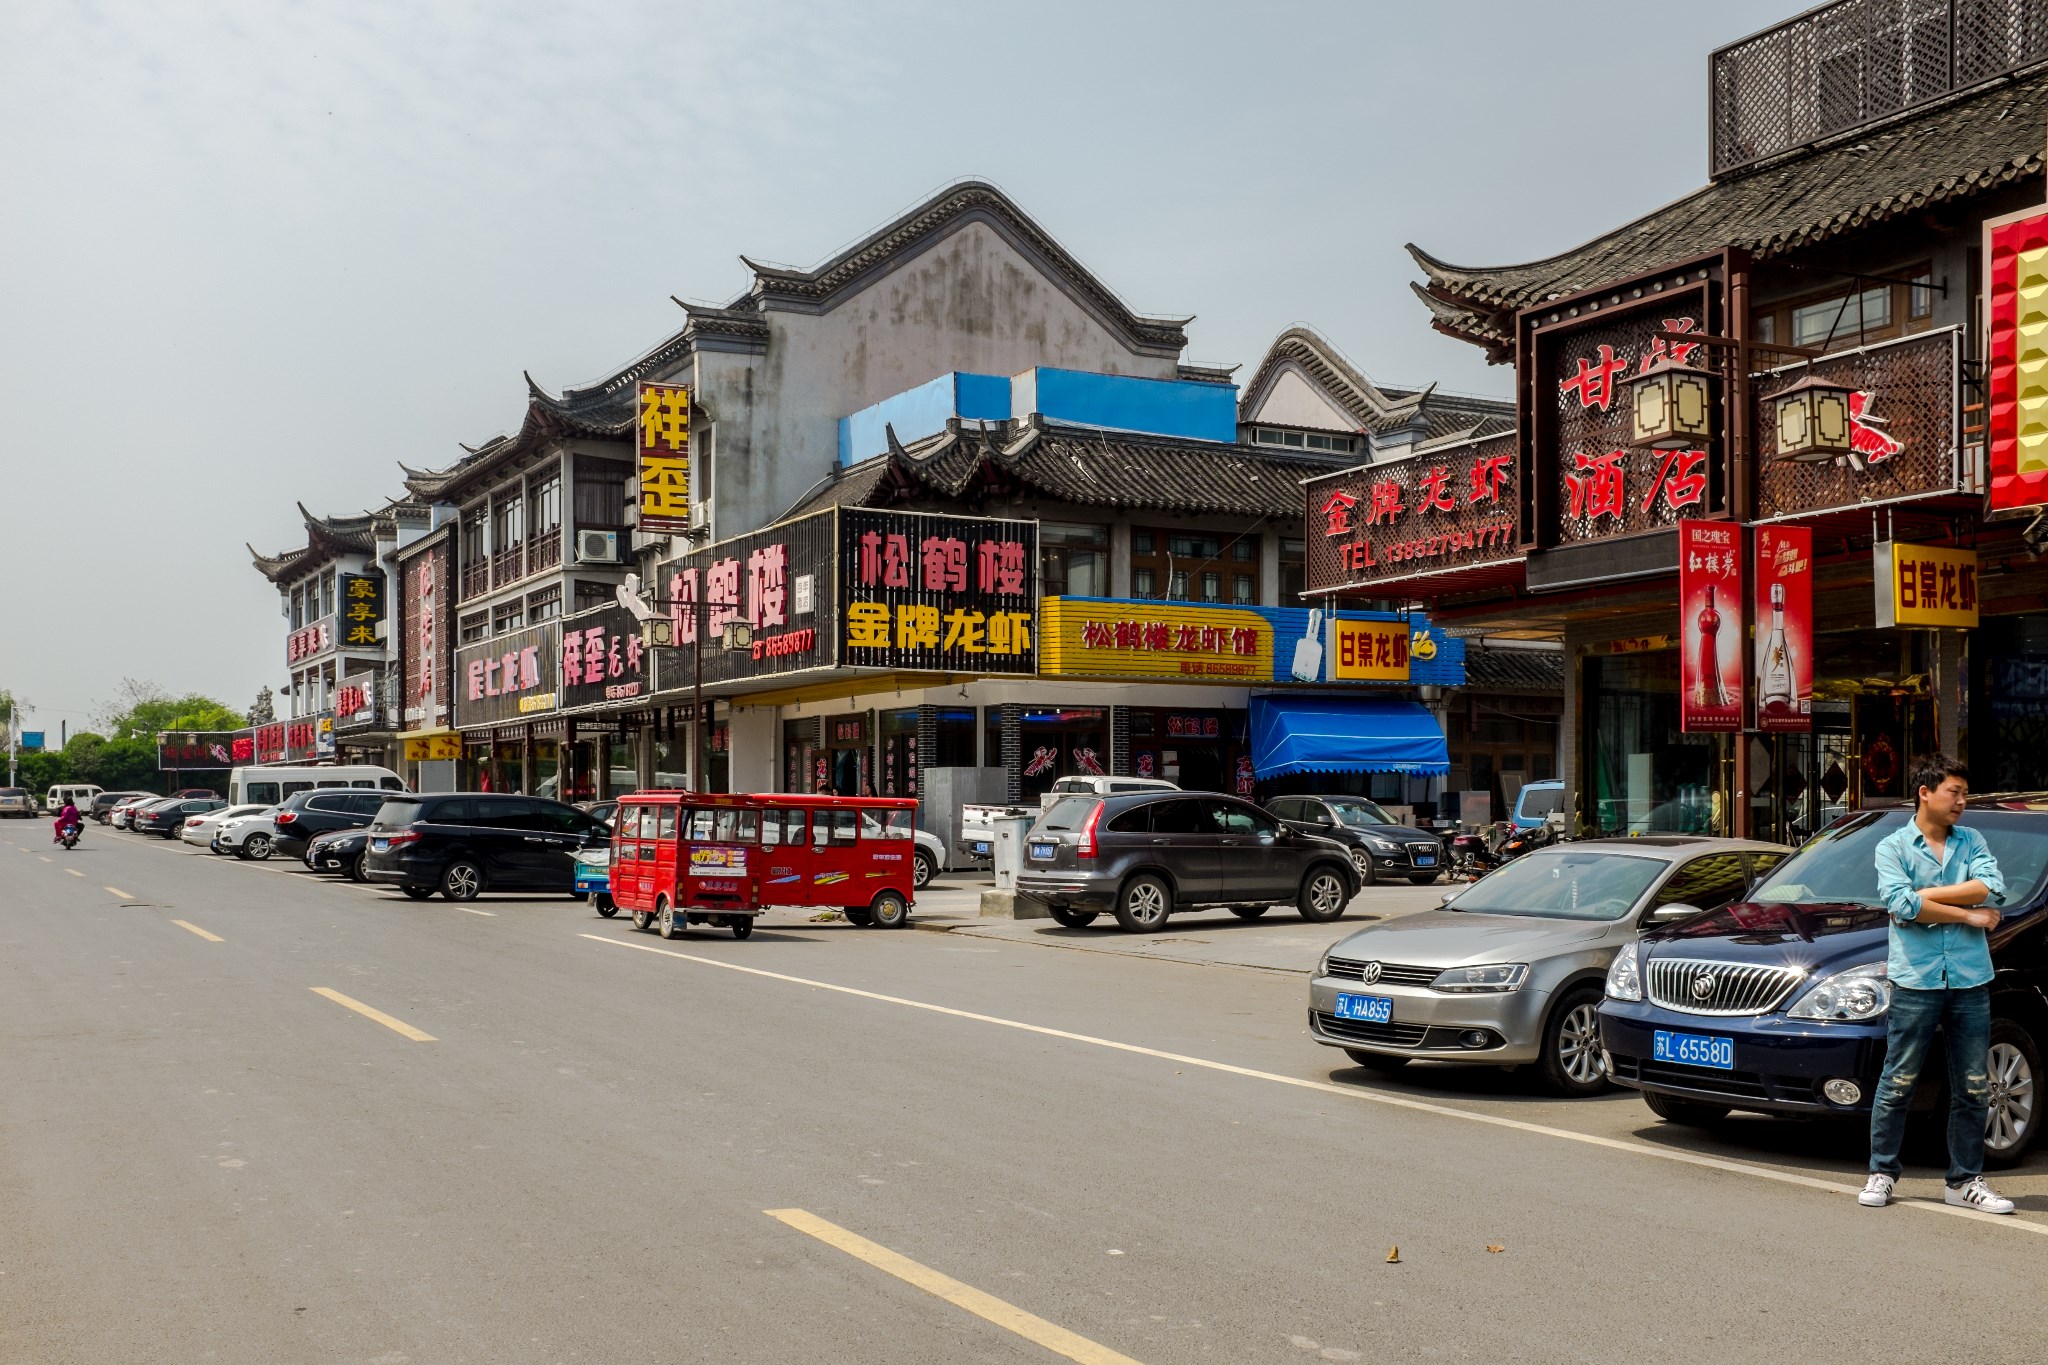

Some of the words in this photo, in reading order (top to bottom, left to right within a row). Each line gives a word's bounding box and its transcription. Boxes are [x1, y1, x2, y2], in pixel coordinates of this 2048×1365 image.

[641, 388, 688, 516] 祥歪
[1321, 455, 1510, 536] 金牌龙虾
[1565, 450, 1705, 520] 酒店
[861, 531, 1024, 594] 松鹤楼
[1340, 540, 1376, 570] TEL
[1386, 524, 1513, 563] 13852794777
[1691, 529, 1731, 544] 国之瑰宝
[347, 579, 376, 644] 豪享来
[671, 544, 788, 646] 松鹤楼
[1899, 560, 1976, 611] 甘棠龙虾
[766, 629, 815, 657] 86589877
[848, 602, 1031, 655] 金牌龙虾
[1082, 620, 1258, 655] 松鹤楼龙虾馆
[1341, 631, 1408, 668] 甘棠龙虾
